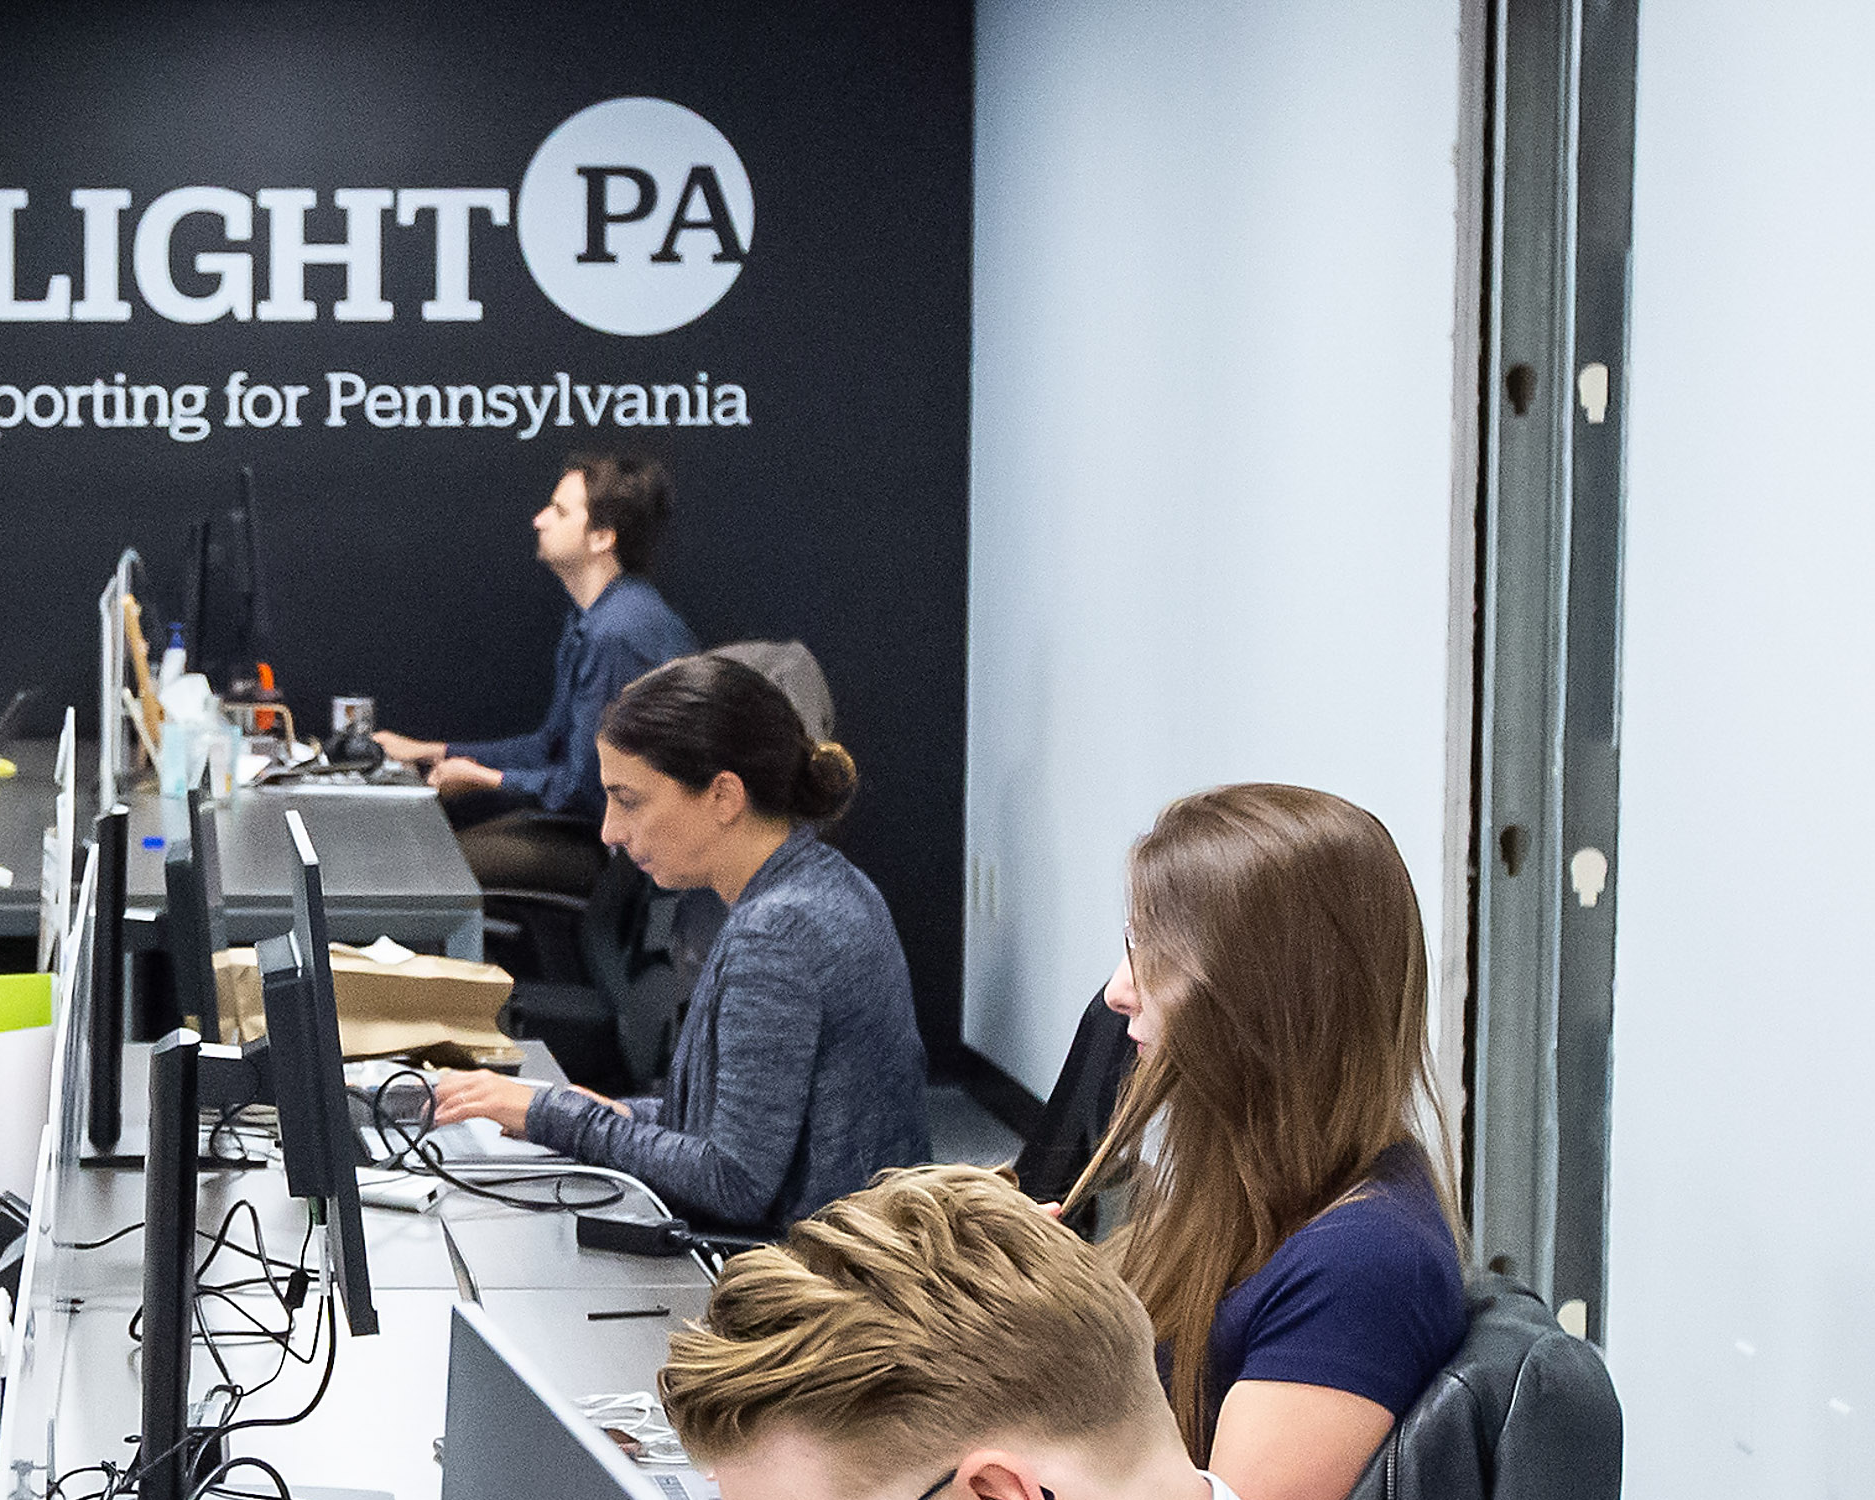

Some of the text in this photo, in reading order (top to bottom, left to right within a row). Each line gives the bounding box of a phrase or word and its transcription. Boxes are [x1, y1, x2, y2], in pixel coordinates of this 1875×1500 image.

[576, 166, 743, 264] PA
[224, 372, 311, 429] for
[325, 372, 752, 441] Pennsylvania
